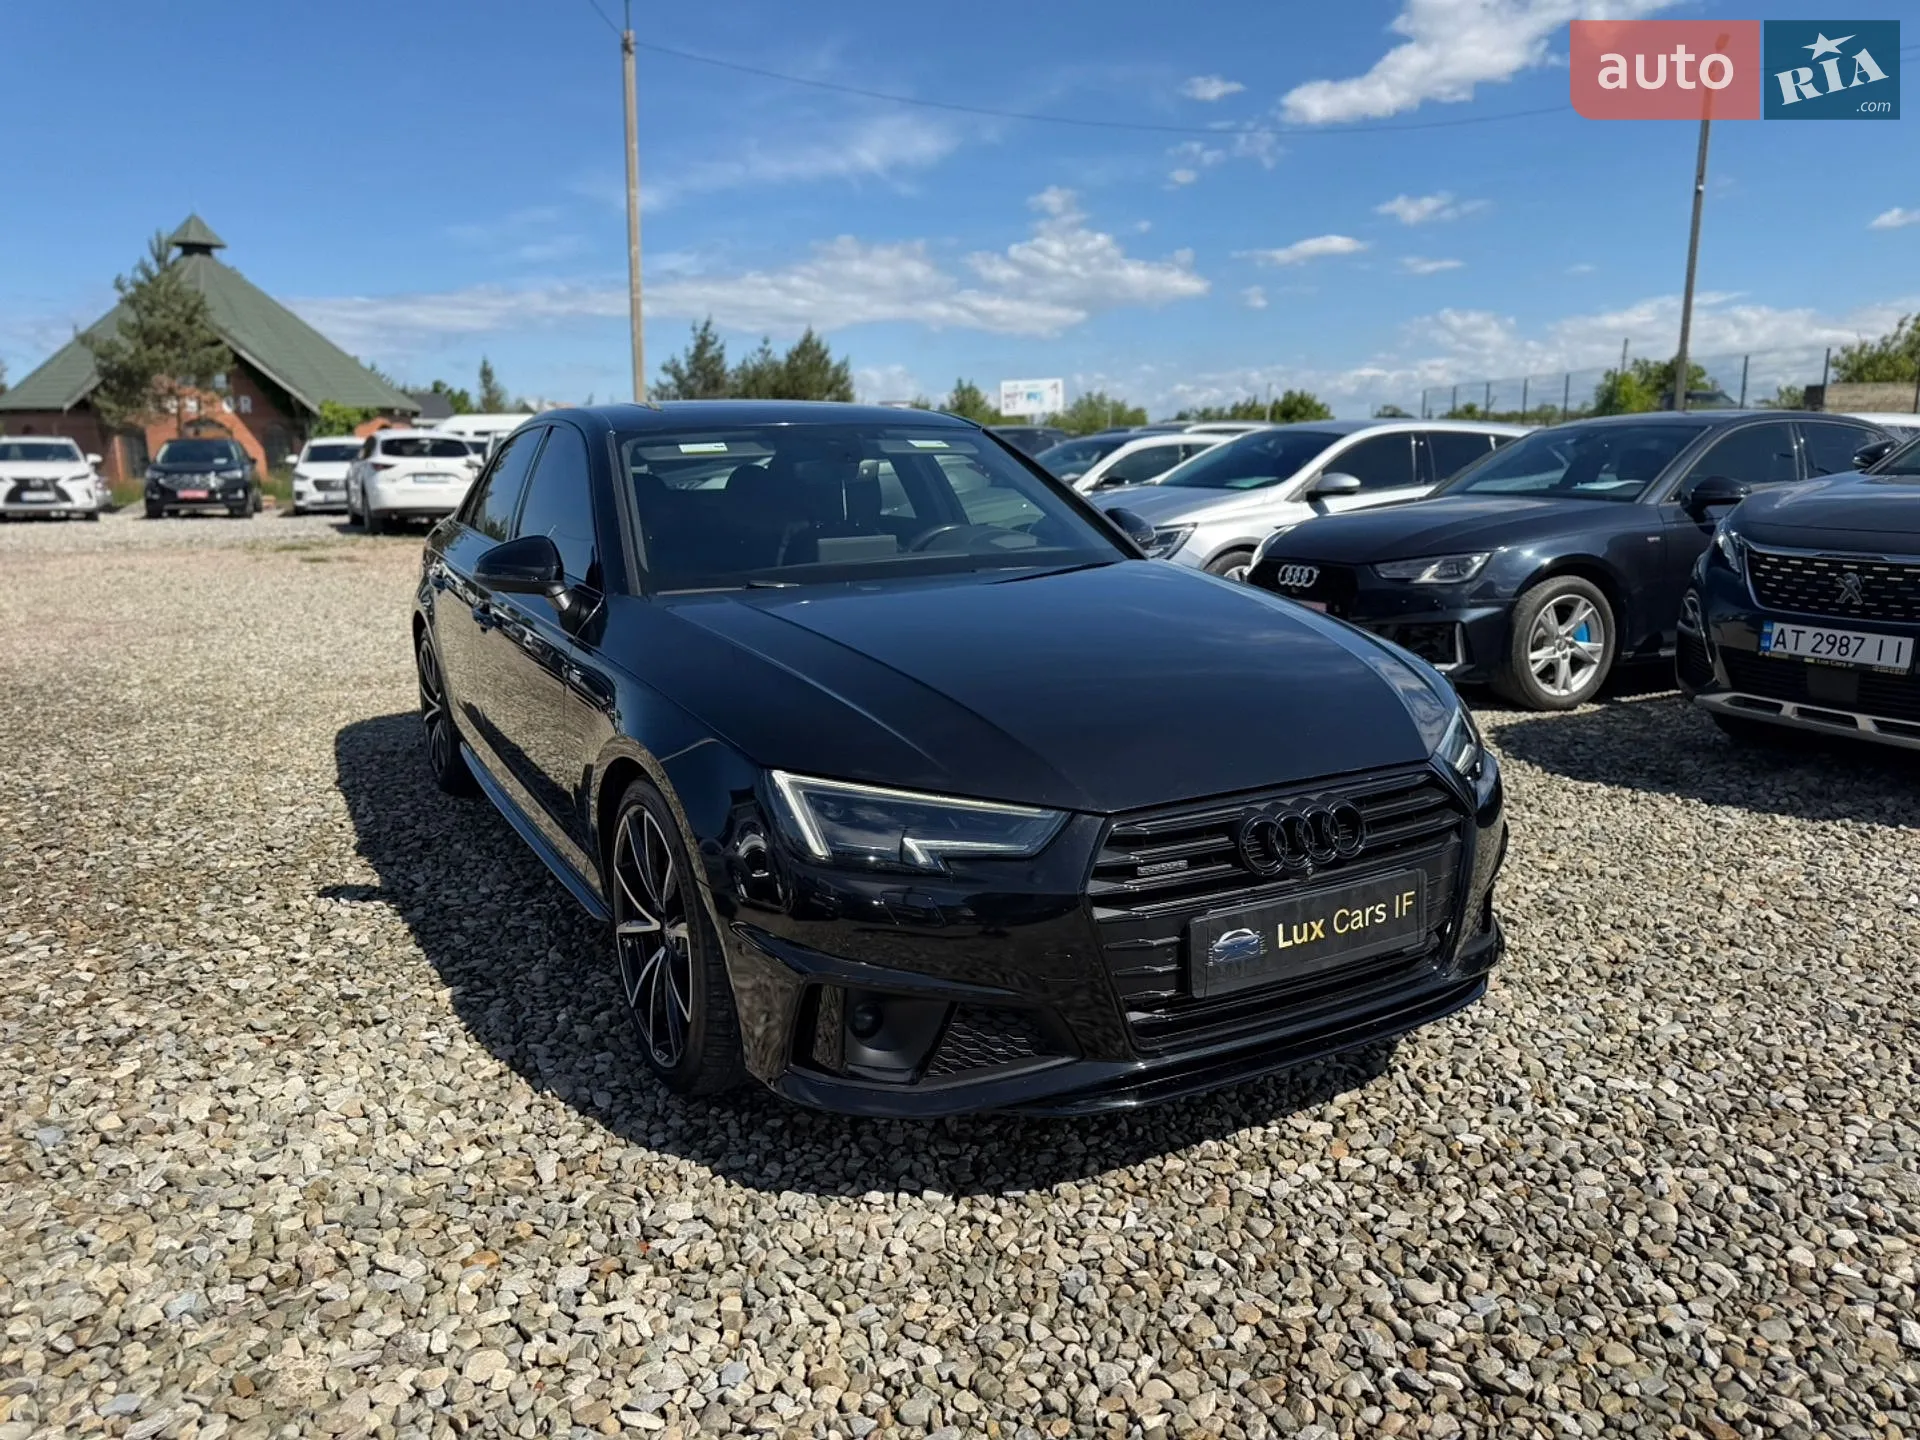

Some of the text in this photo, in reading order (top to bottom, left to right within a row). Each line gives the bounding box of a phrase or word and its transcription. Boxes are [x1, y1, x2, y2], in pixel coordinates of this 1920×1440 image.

[1773, 628, 1806, 651] AT
[1811, 632, 1866, 658] 2987
[1277, 891, 1416, 949] Lux Cars IF
